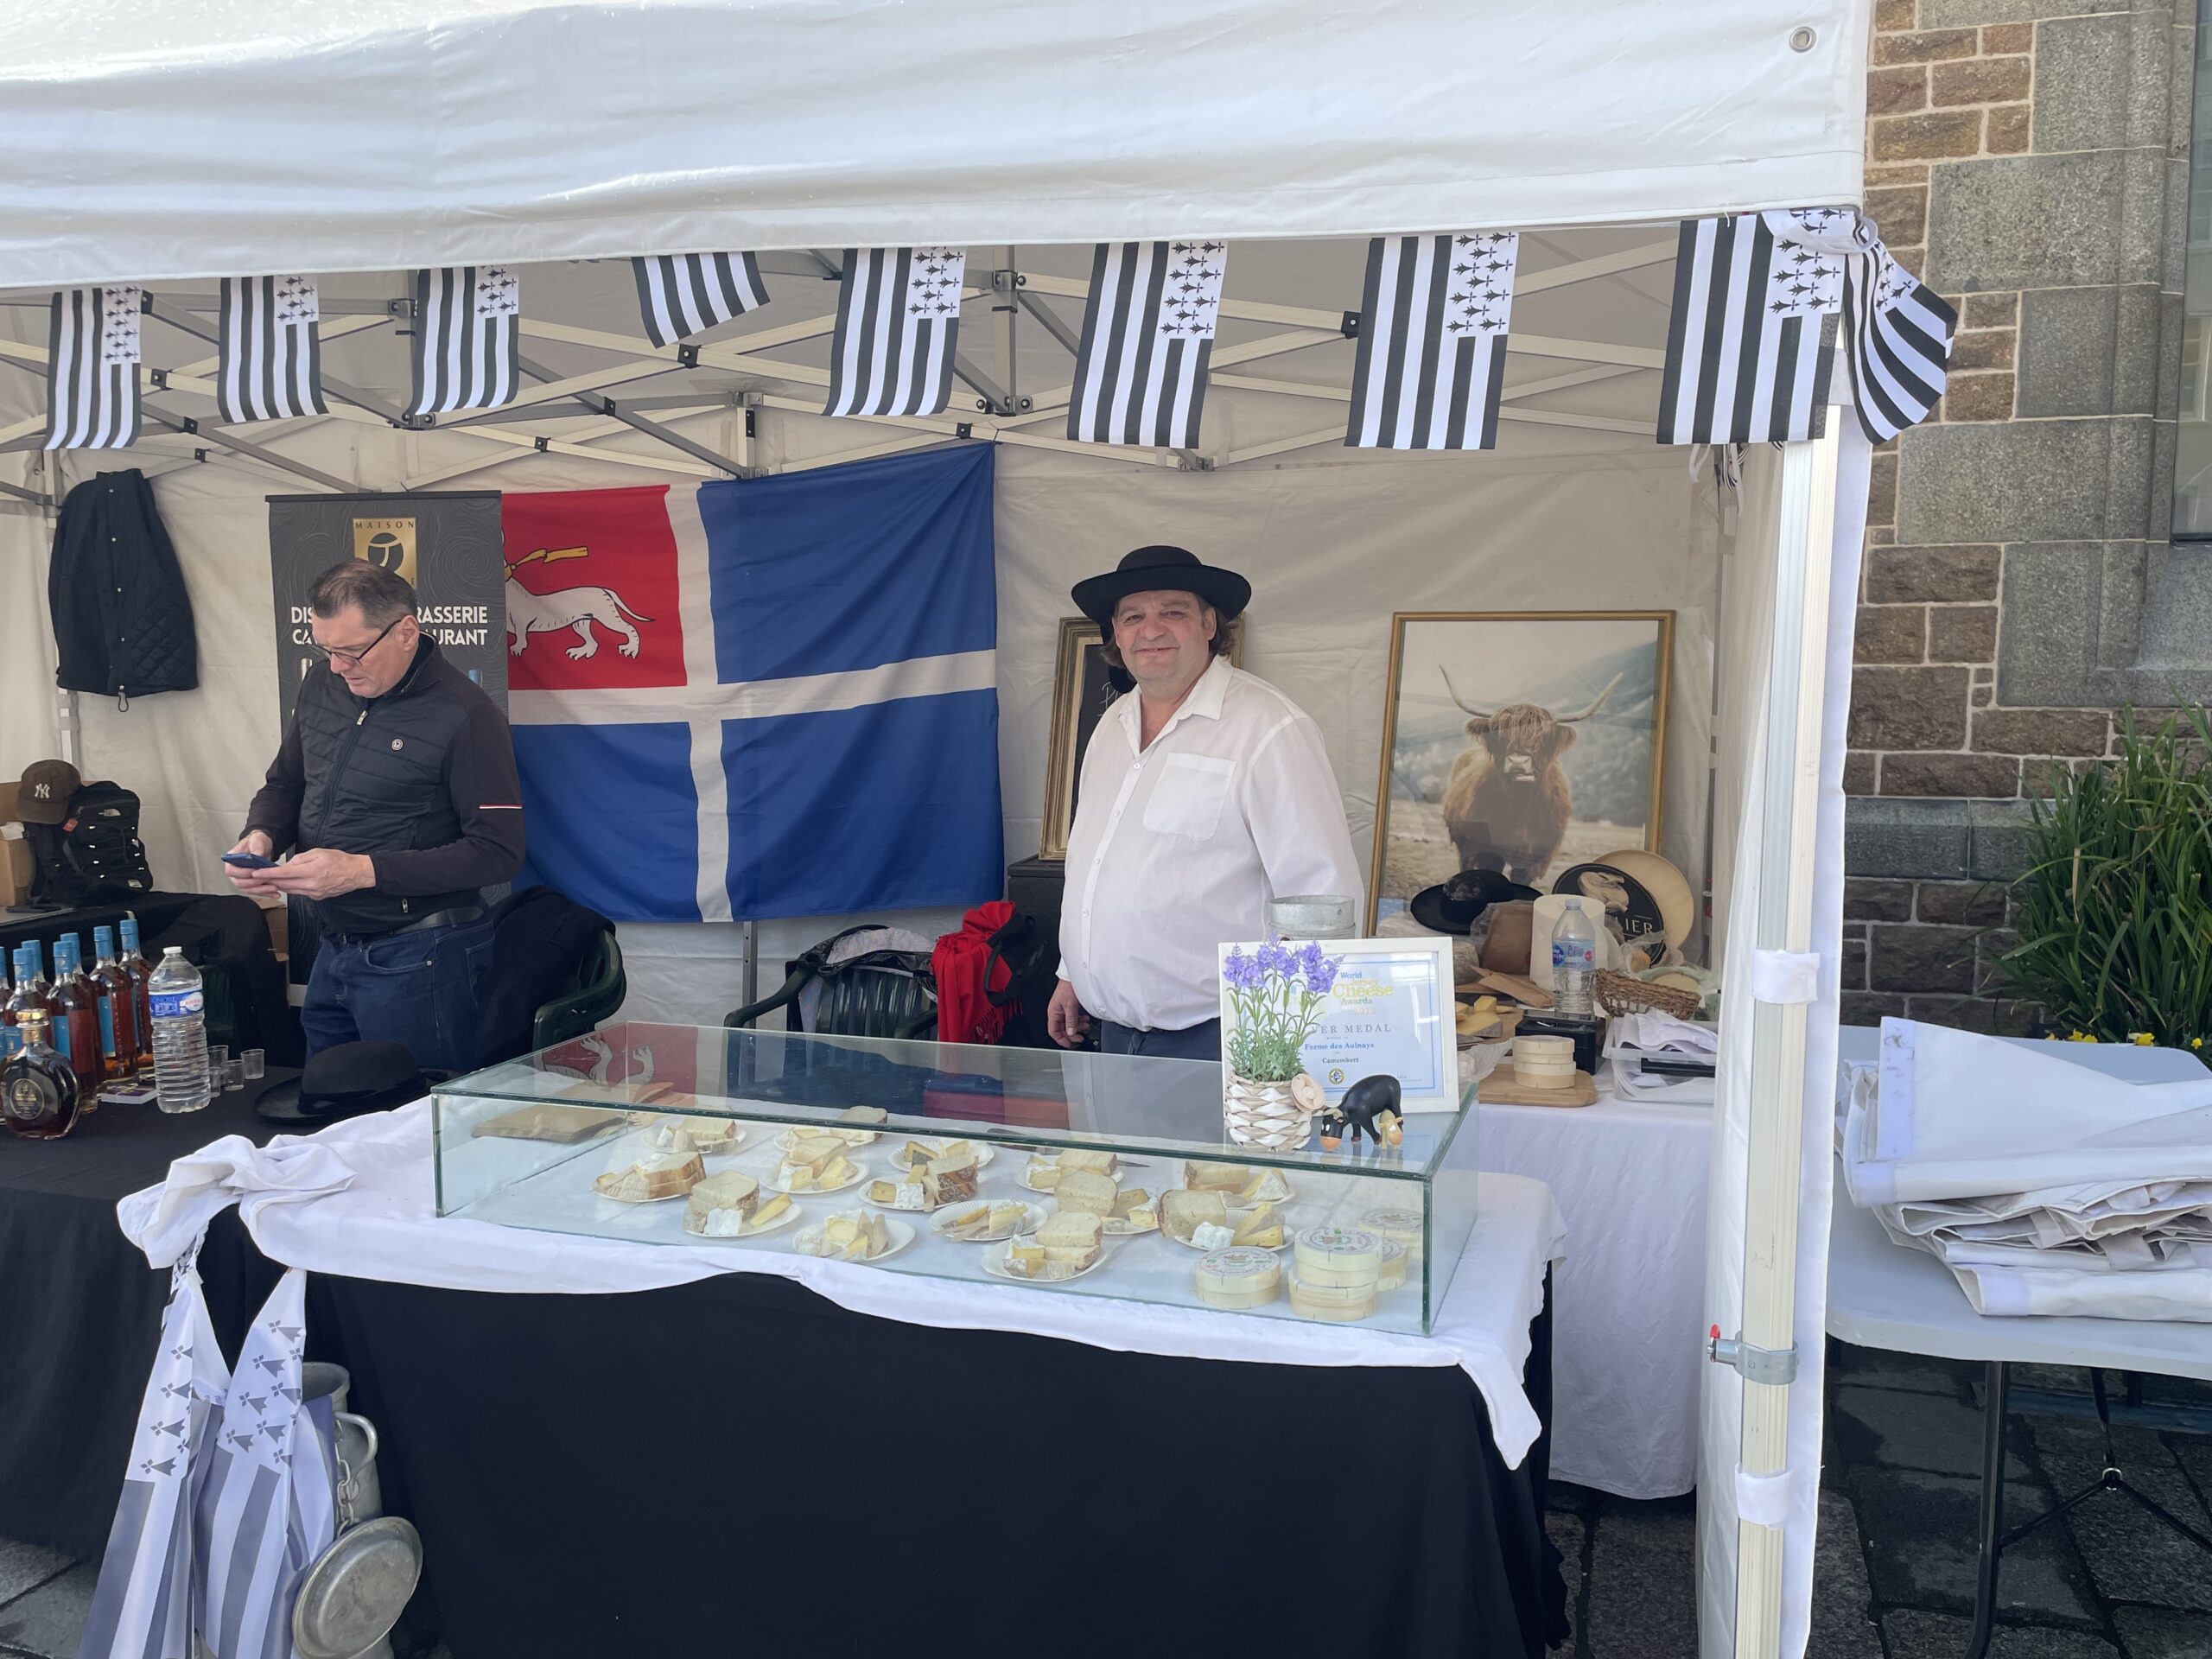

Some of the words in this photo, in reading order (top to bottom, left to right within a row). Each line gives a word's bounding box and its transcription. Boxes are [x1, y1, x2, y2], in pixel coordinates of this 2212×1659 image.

[416, 606, 488, 624] RASSERIE
[1624, 918, 1653, 934] IER
[1332, 983, 1394, 998] Cheese
[1344, 1023, 1391, 1033] MEDAL
